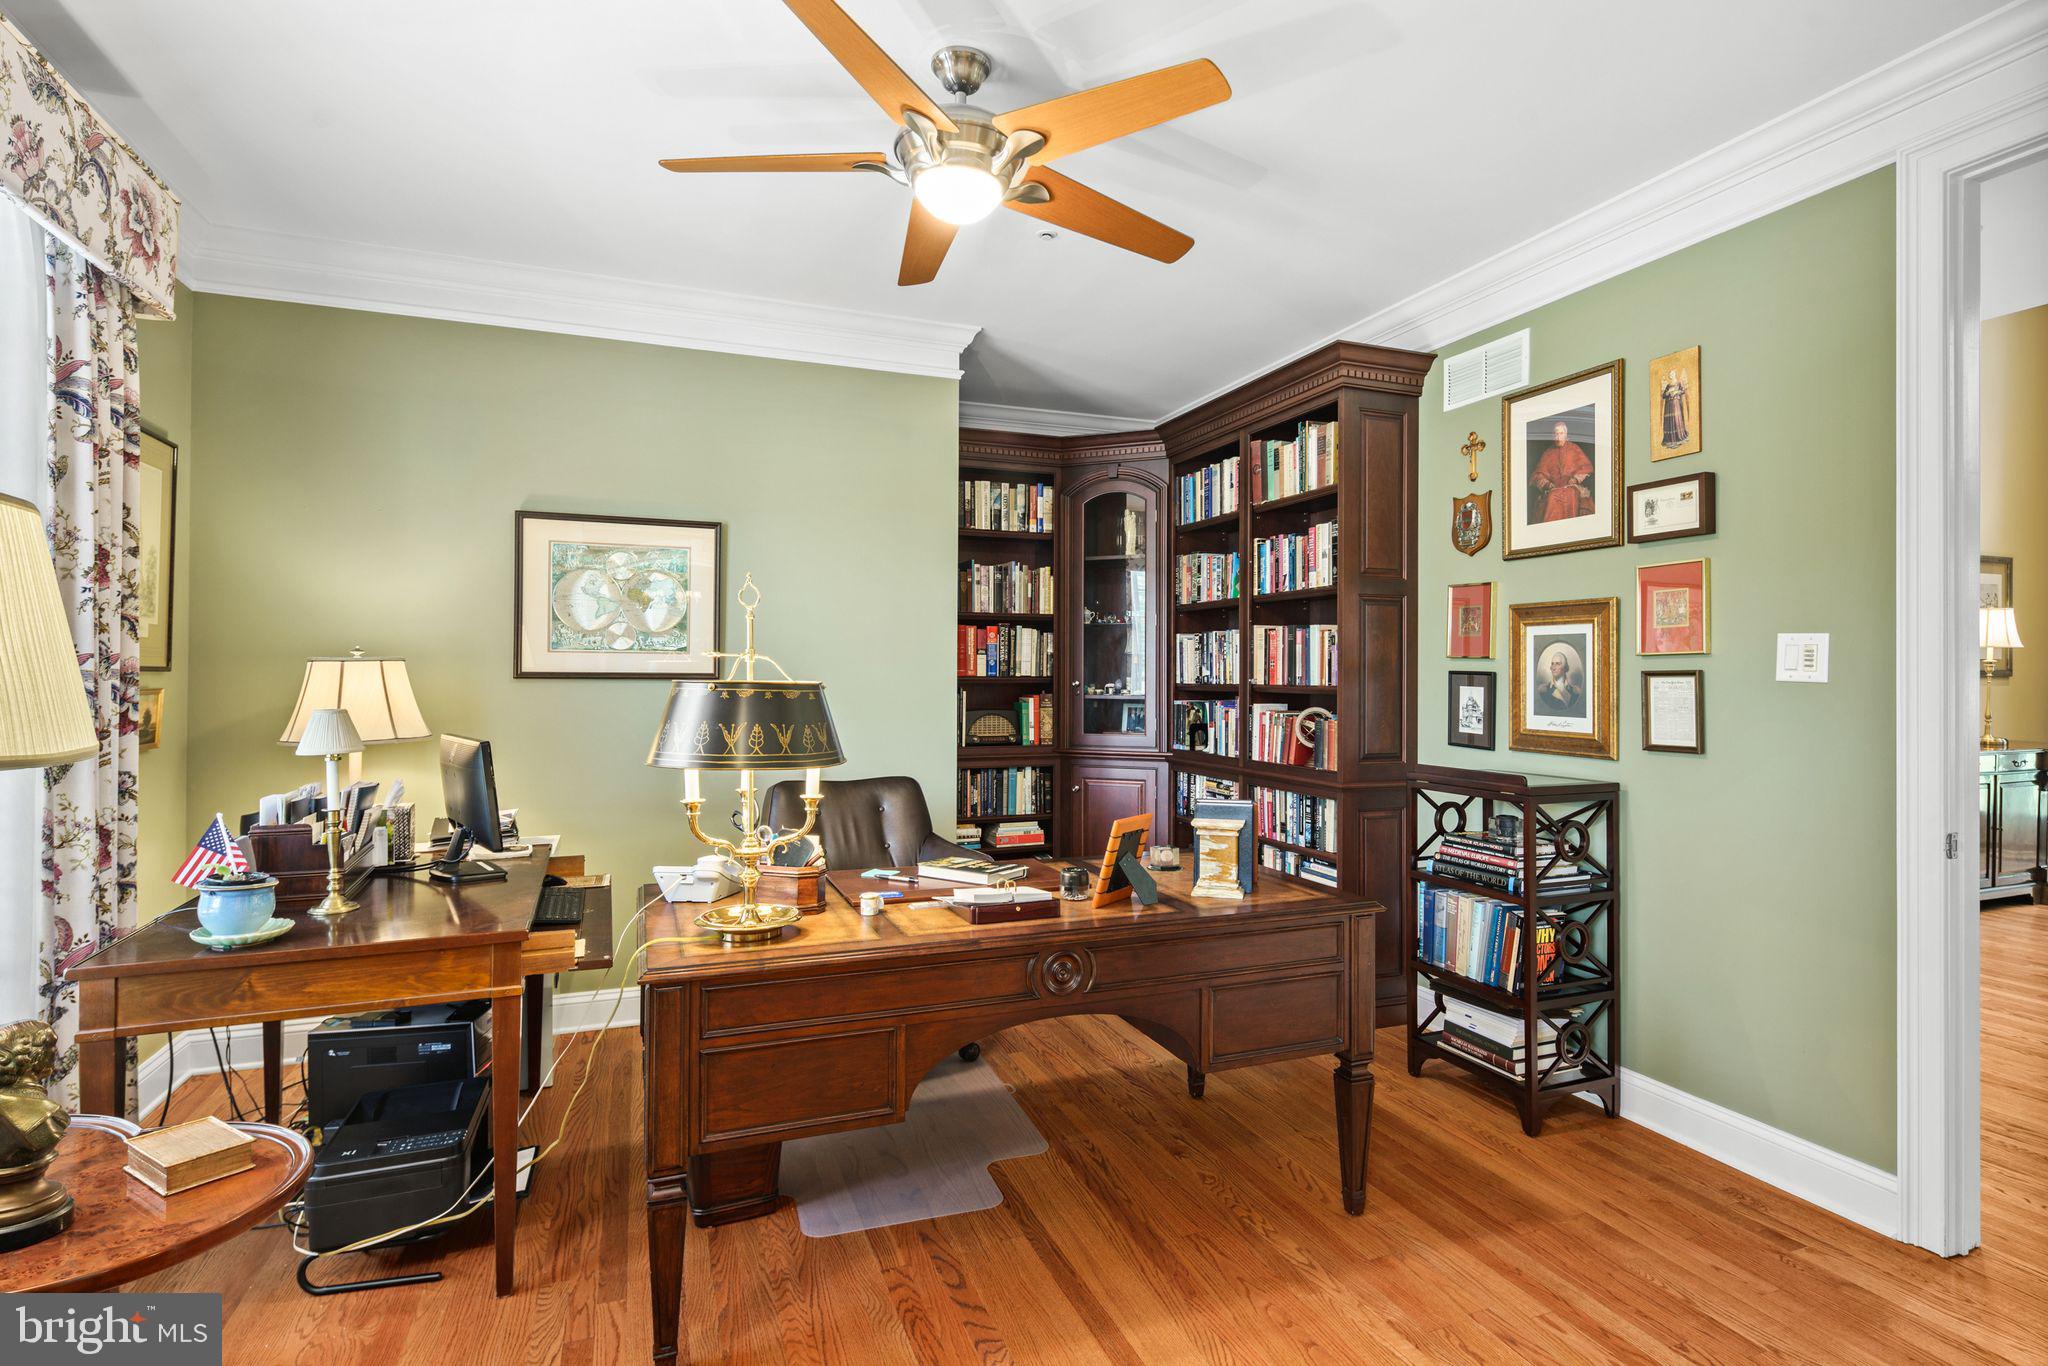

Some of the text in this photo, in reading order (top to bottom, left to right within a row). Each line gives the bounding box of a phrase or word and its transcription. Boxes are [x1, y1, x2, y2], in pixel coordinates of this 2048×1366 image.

[1308, 533, 1316, 567] TRIUMPH
[1447, 848, 1470, 859] MEDIEVAL
[1471, 853, 1489, 862] EUROPE
[1434, 864, 1455, 874] ATLAS
[1455, 868, 1465, 876] OF
[1466, 870, 1480, 880] THE
[1481, 875, 1507, 887] WORLD
[1470, 861, 1487, 869] WORLD
[1487, 864, 1506, 873] HISTORY
